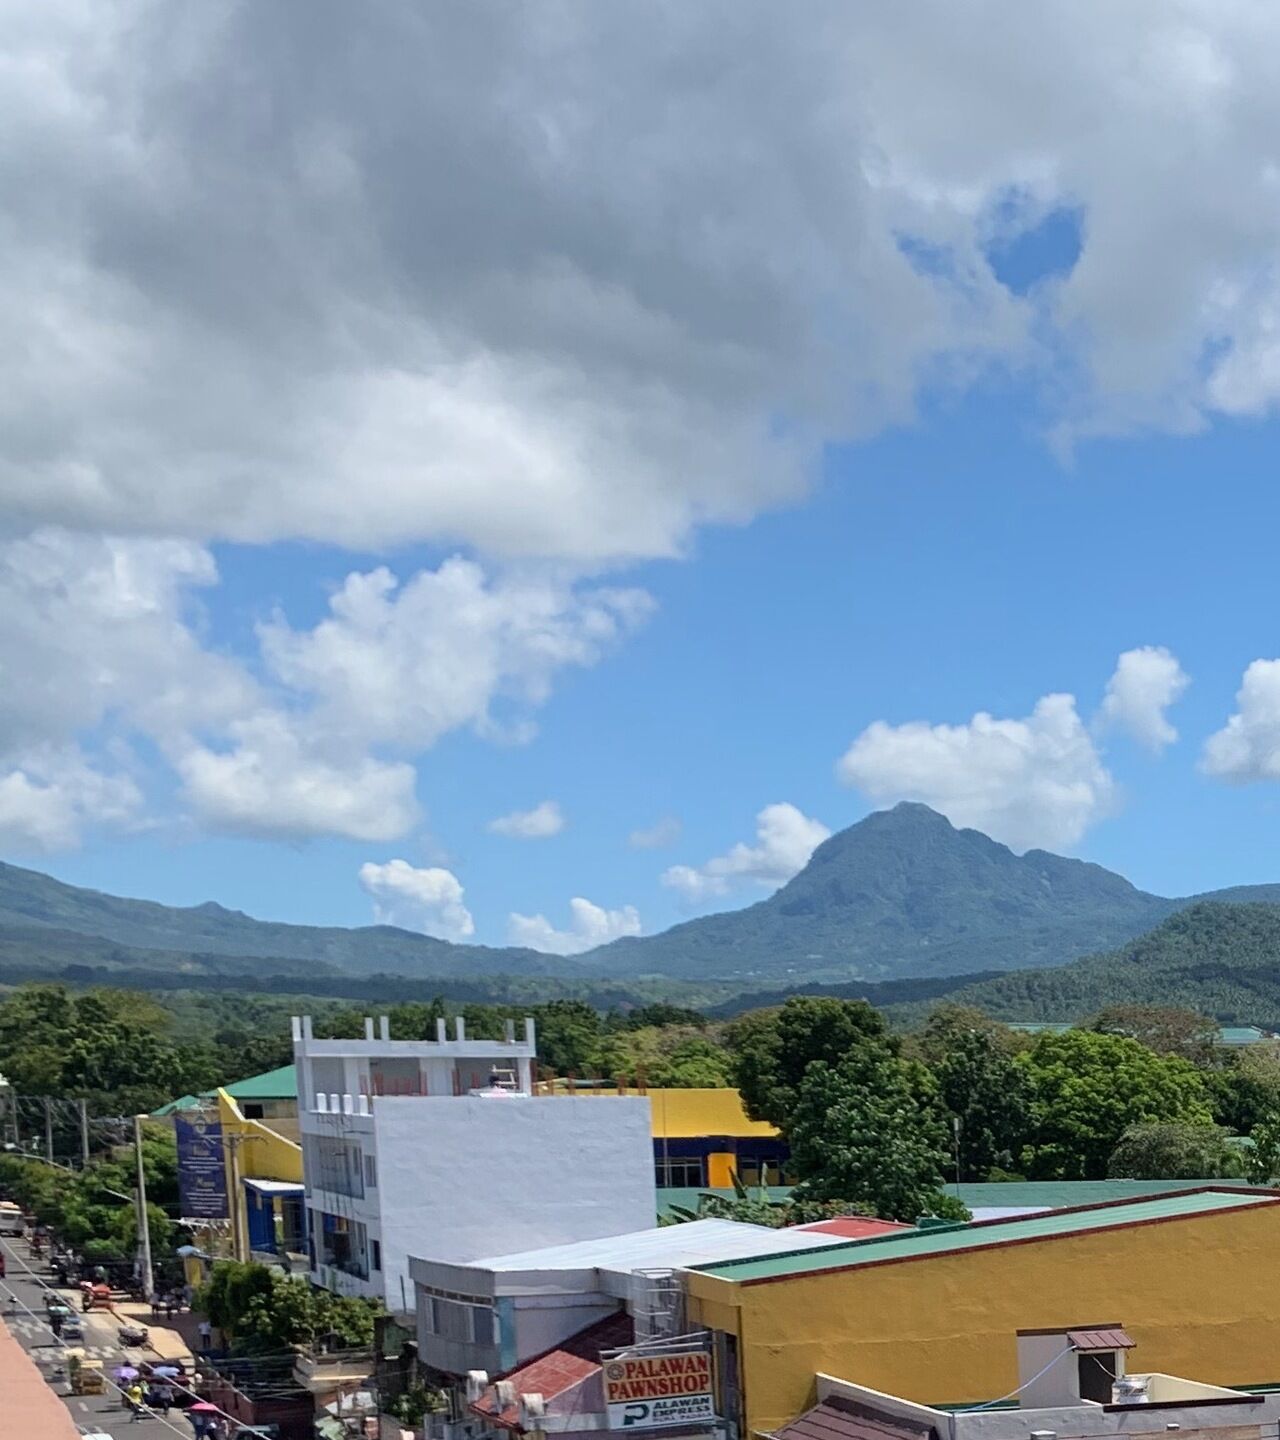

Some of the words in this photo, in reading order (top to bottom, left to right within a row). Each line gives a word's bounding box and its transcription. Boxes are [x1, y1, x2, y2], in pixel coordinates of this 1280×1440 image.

[625, 1355, 708, 1379] PALAWAN
[607, 1374, 710, 1400] PAWNSHOP
[653, 1405, 711, 1418] EXPRESS
